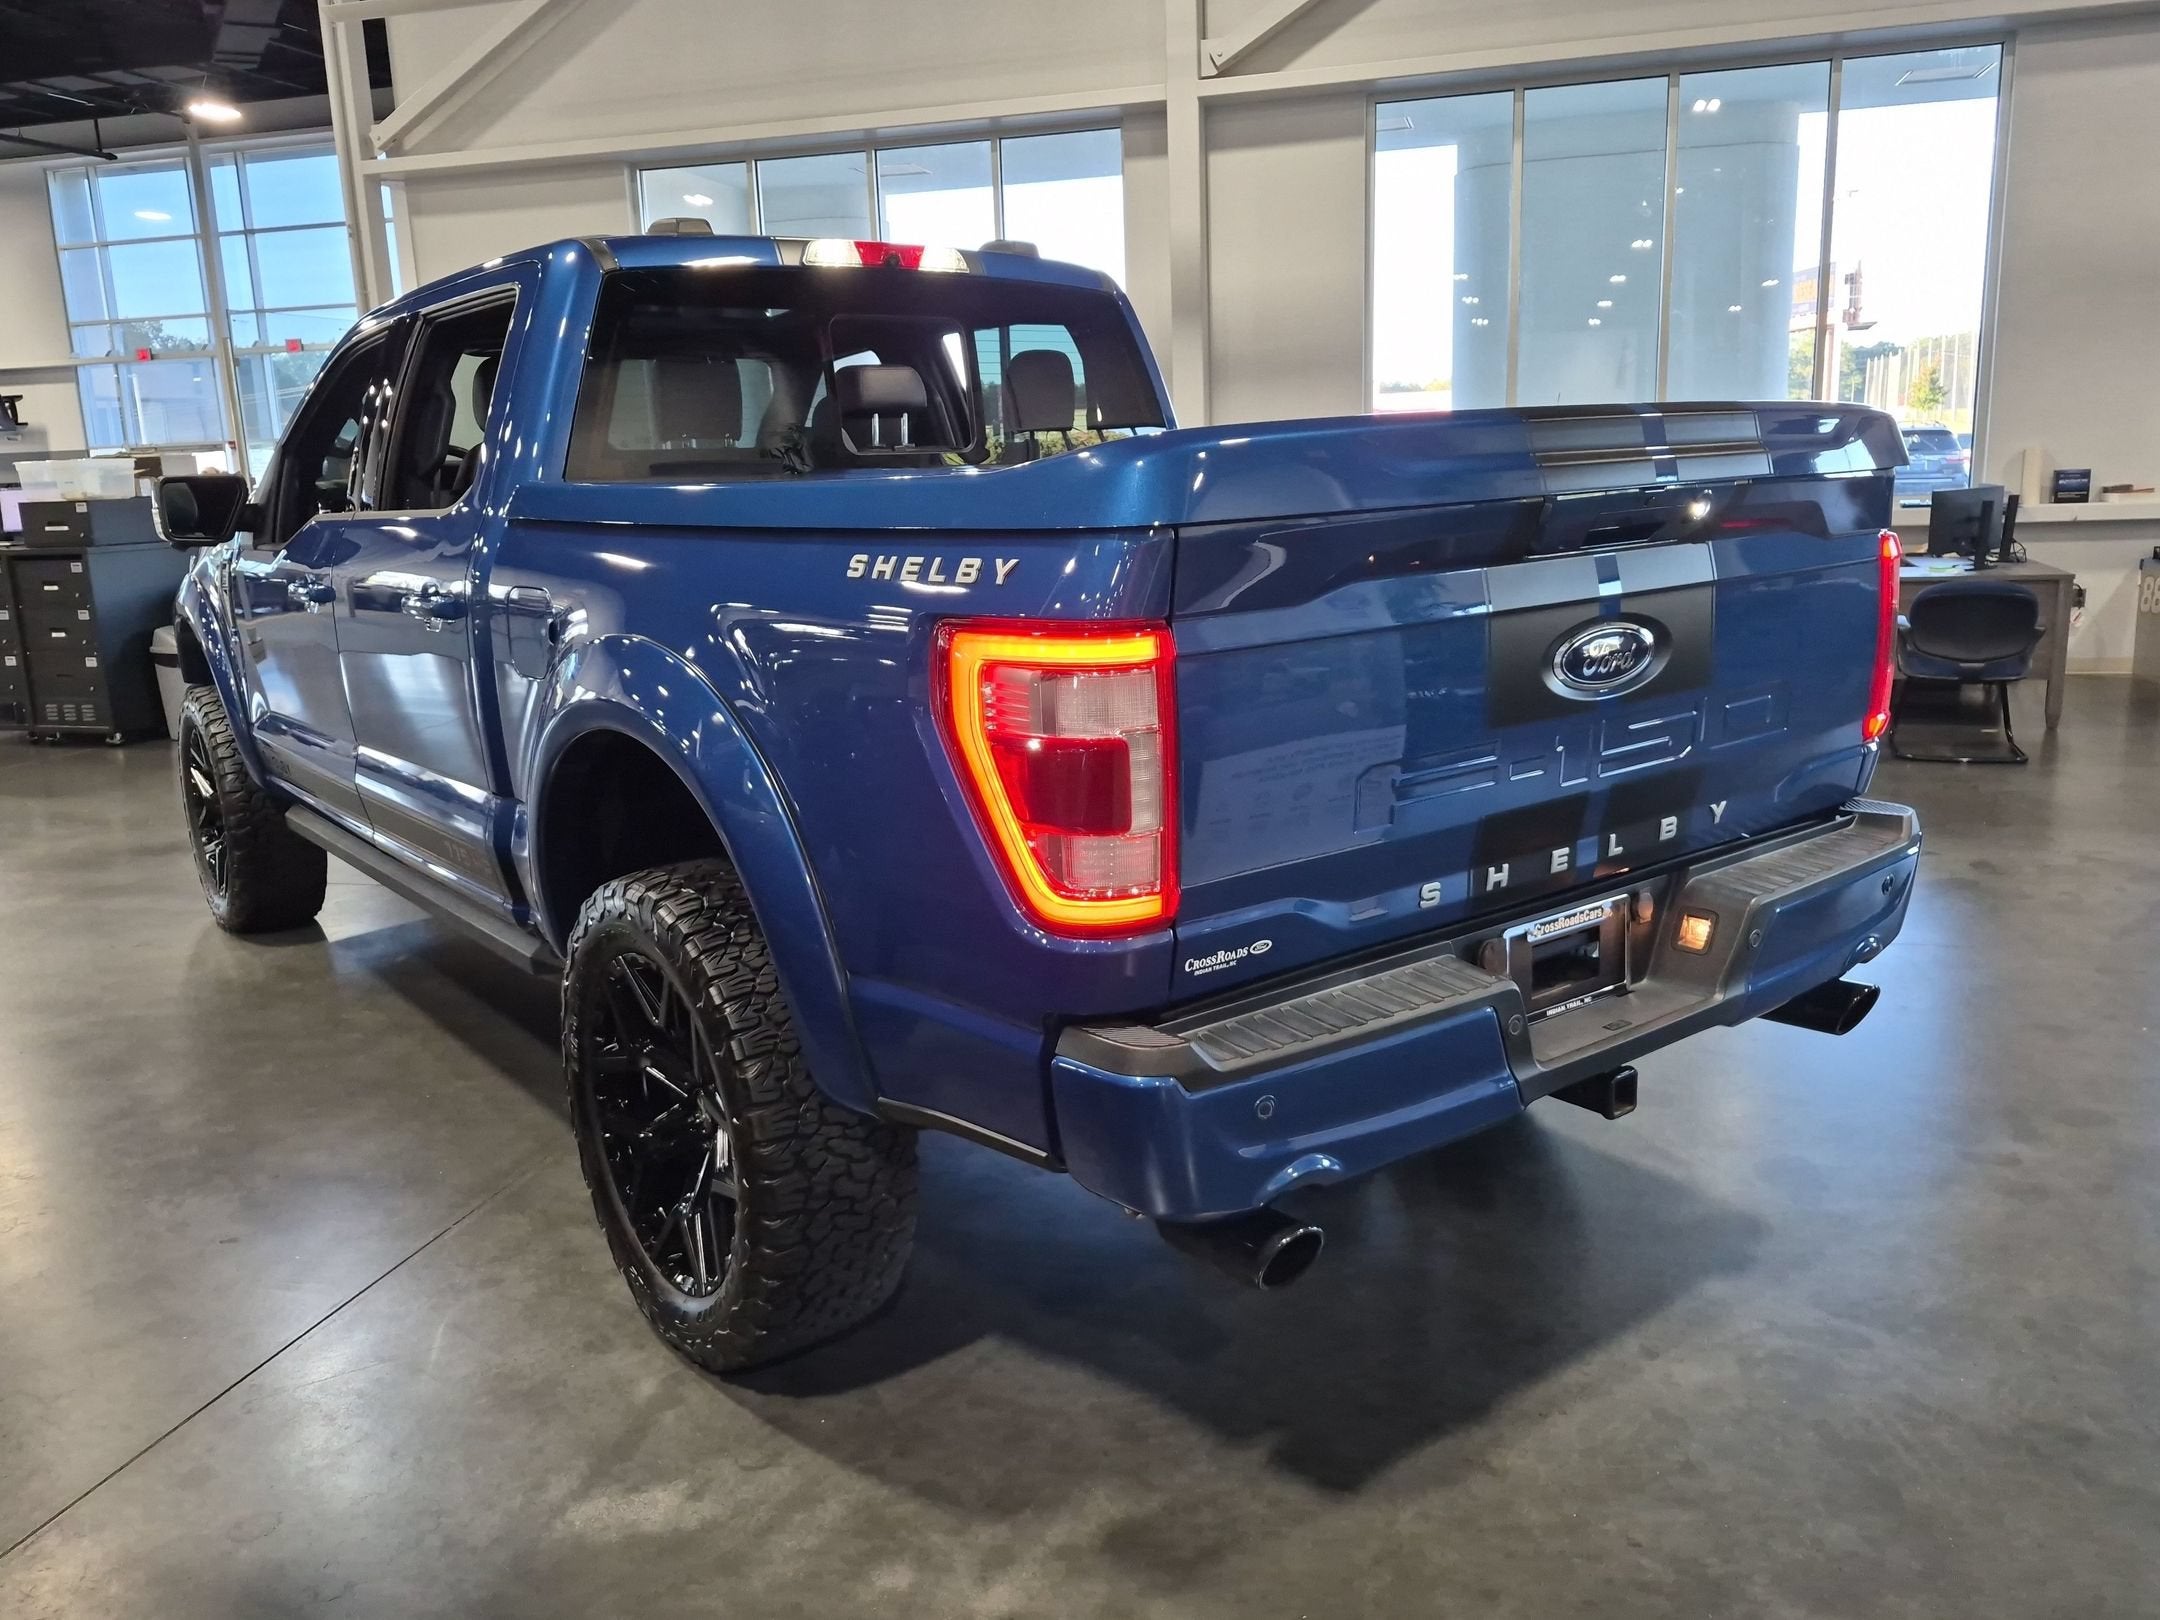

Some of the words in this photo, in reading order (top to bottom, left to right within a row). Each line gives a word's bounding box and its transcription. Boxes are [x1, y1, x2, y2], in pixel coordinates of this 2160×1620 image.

[847, 553, 1020, 585] SHELBY
[1582, 636, 1637, 677] Ford
[1418, 800, 1727, 909] SHELBY
